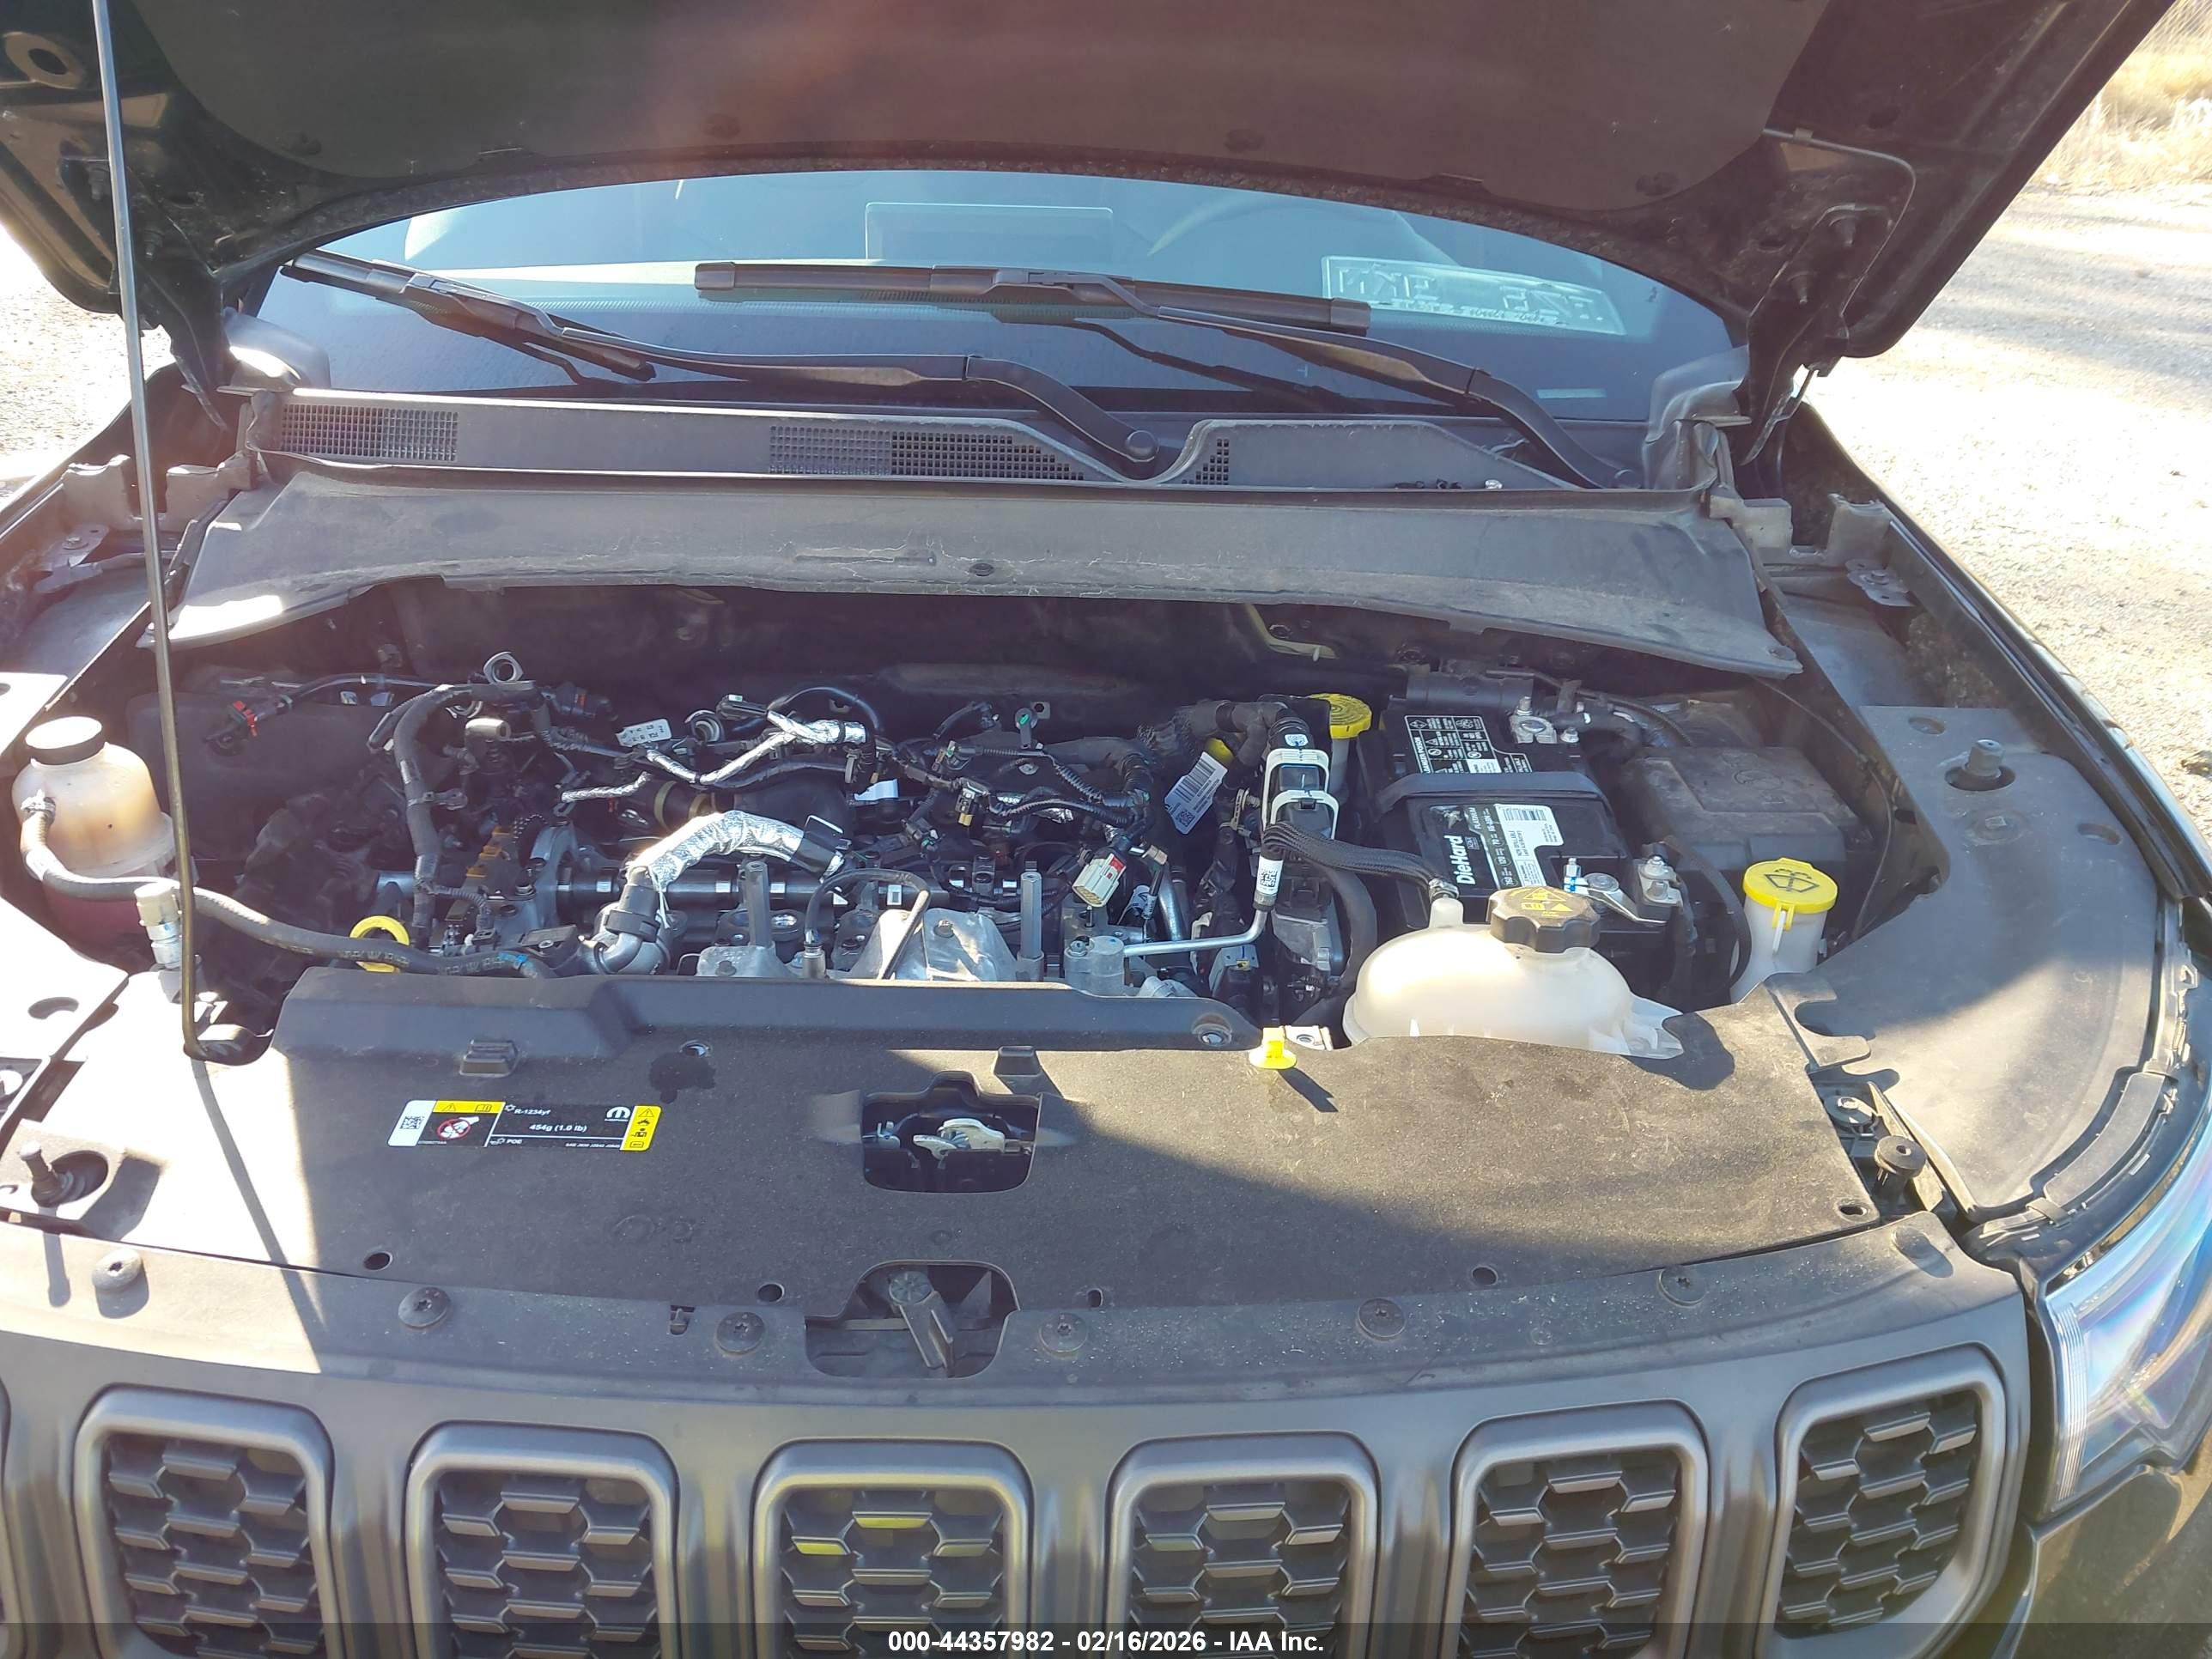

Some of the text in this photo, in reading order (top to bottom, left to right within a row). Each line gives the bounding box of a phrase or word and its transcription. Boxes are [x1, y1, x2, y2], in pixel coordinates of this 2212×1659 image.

[1469, 807, 1482, 830] PLATINUM
[1443, 835, 1476, 884] DieHard
[574, 1124, 587, 1133] lb)
